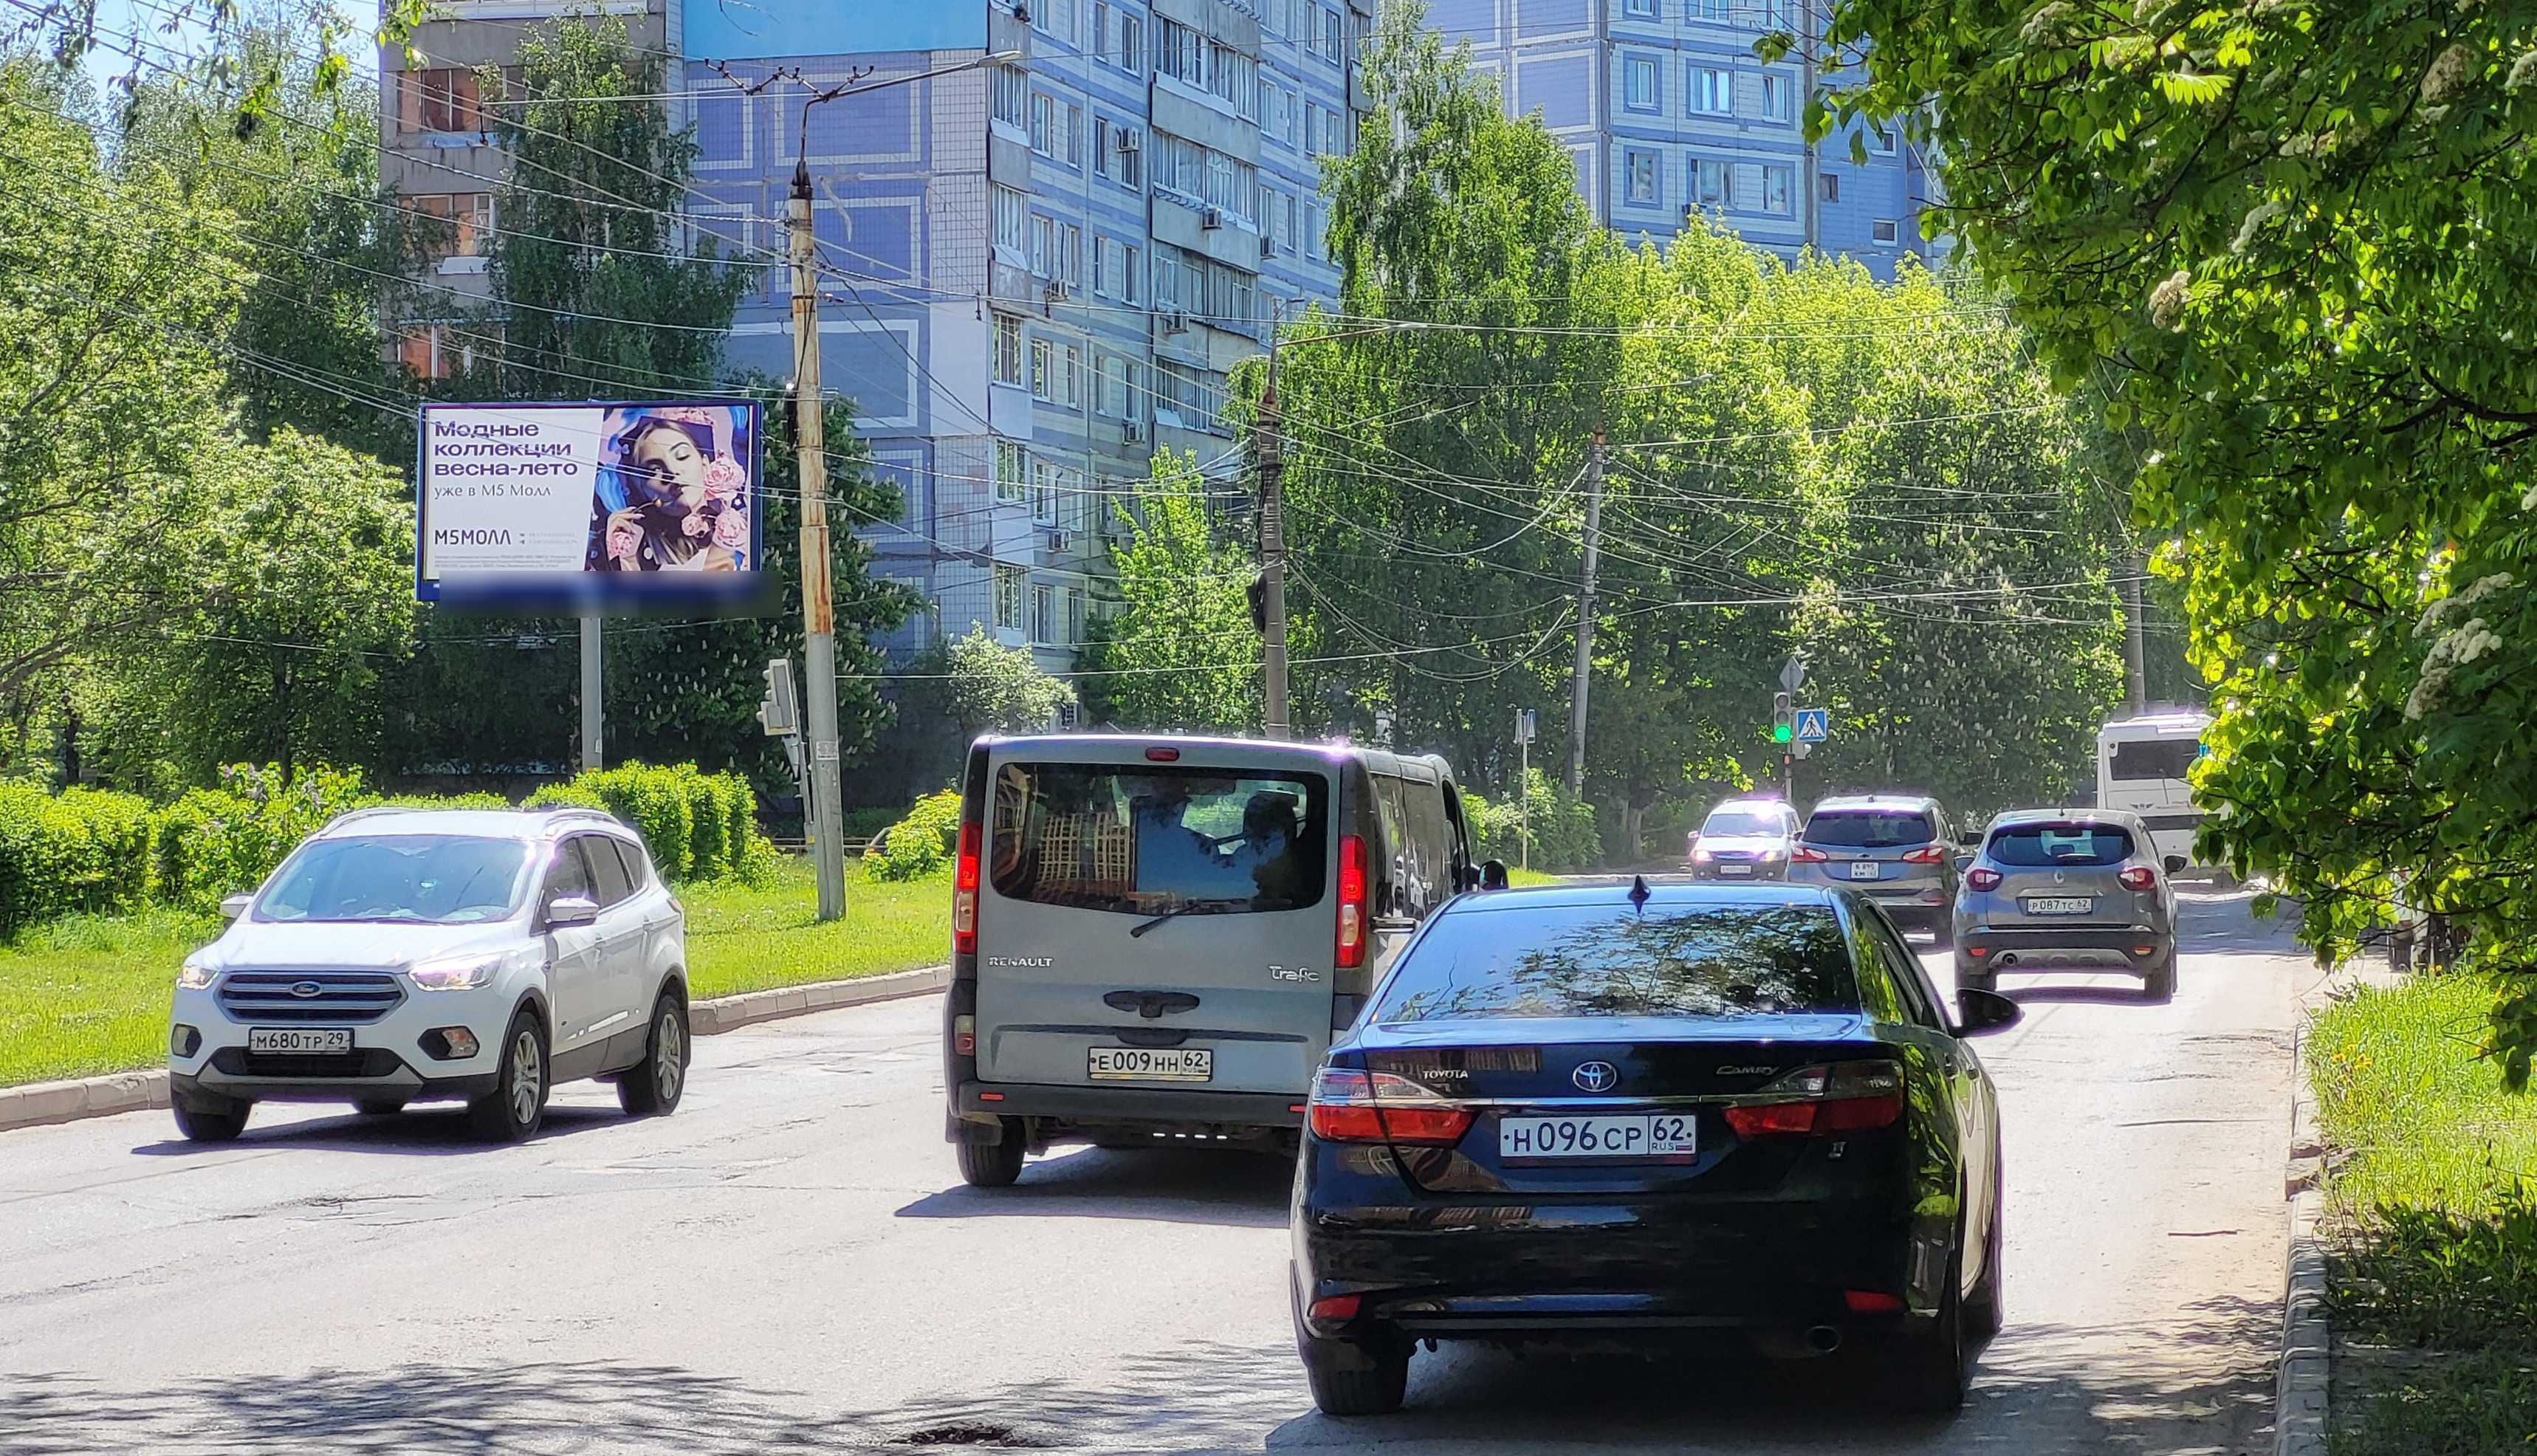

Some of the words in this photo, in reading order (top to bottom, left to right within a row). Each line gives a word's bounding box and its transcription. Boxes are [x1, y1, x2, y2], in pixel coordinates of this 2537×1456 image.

[435, 421, 539, 438] Модные
[434, 443, 571, 458] коллекции
[434, 463, 578, 476] весна-лето
[434, 486, 463, 500] уже
[468, 487, 476, 496] в
[481, 484, 504, 496] М5
[509, 484, 551, 496] Молл
[989, 957, 1054, 967] RENAULT
[1423, 1070, 1469, 1079] TOYOTA
[1651, 1142, 1674, 1151] RUS
